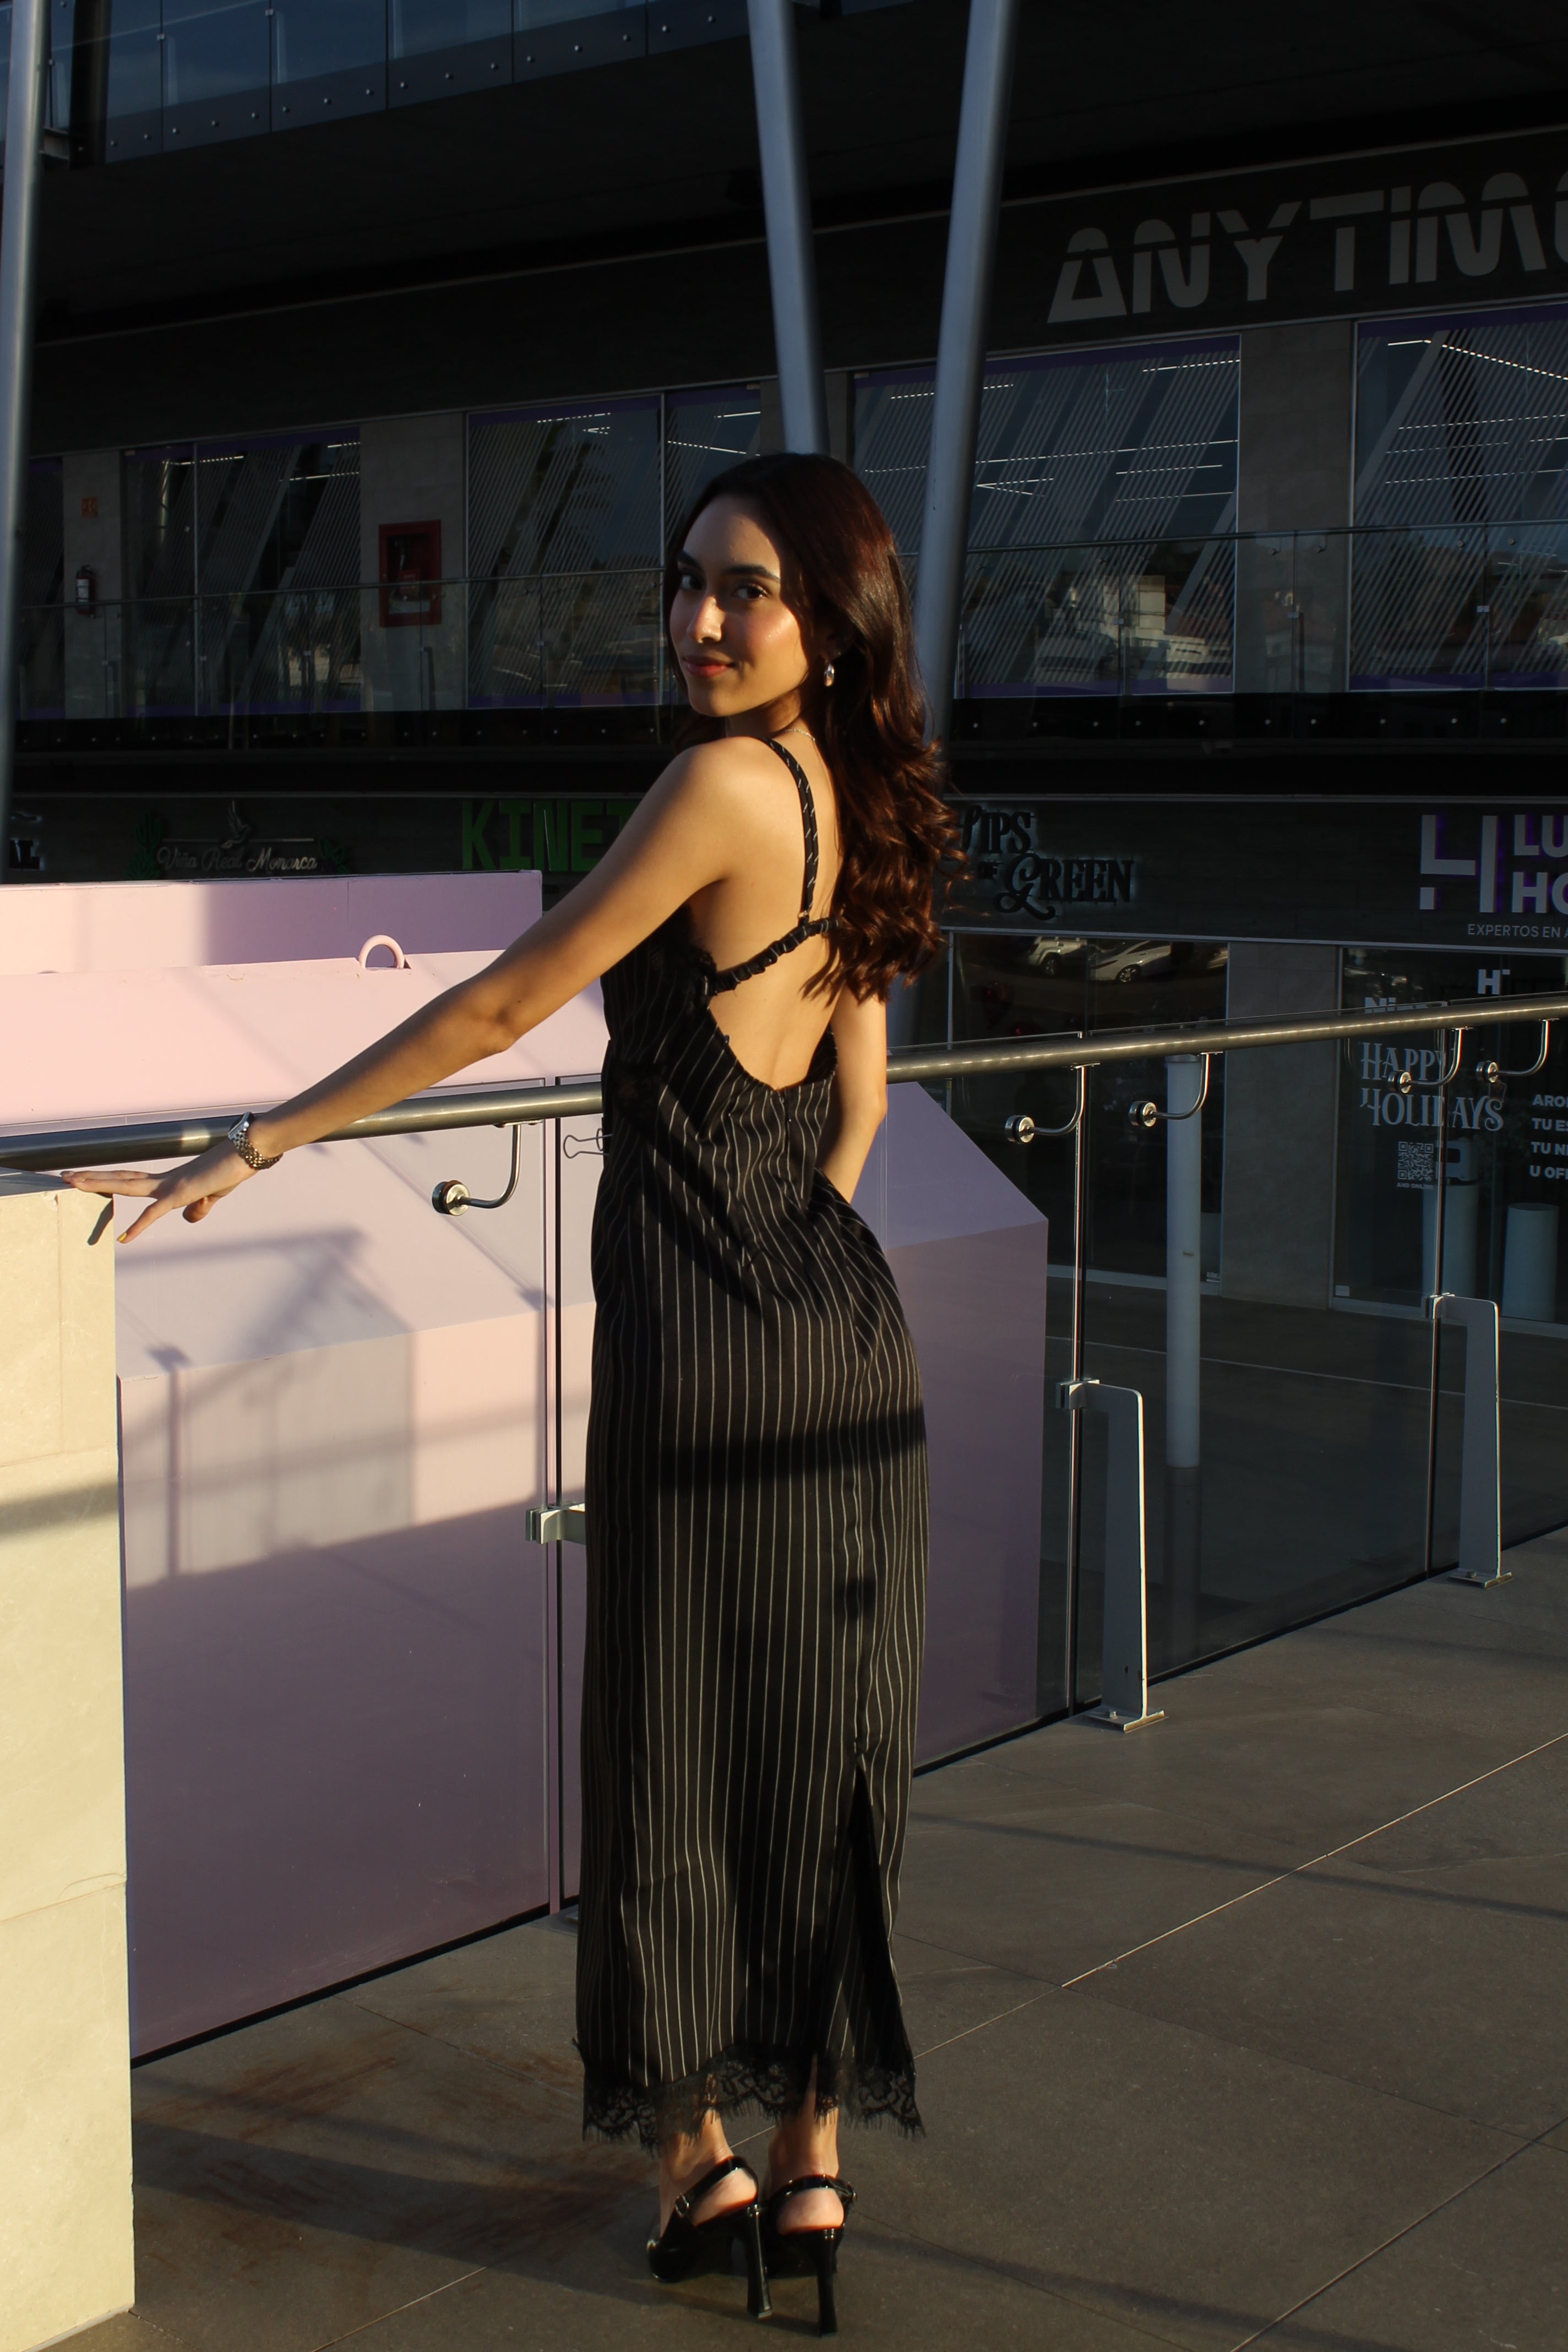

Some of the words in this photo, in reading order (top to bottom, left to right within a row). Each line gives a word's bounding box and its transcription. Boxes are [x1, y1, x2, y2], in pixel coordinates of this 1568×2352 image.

[1047, 170, 1568, 324] ANYTIM
[246, 847, 318, 874] Monarca
[993, 853, 1134, 921] GREEN
[1467, 924, 1539, 938] EXPERTOS
[1543, 926, 1561, 938] EN
[1532, 1093, 1568, 1108] ARO
[1532, 1118, 1553, 1130] TU
[1531, 1141, 1551, 1154] TU
